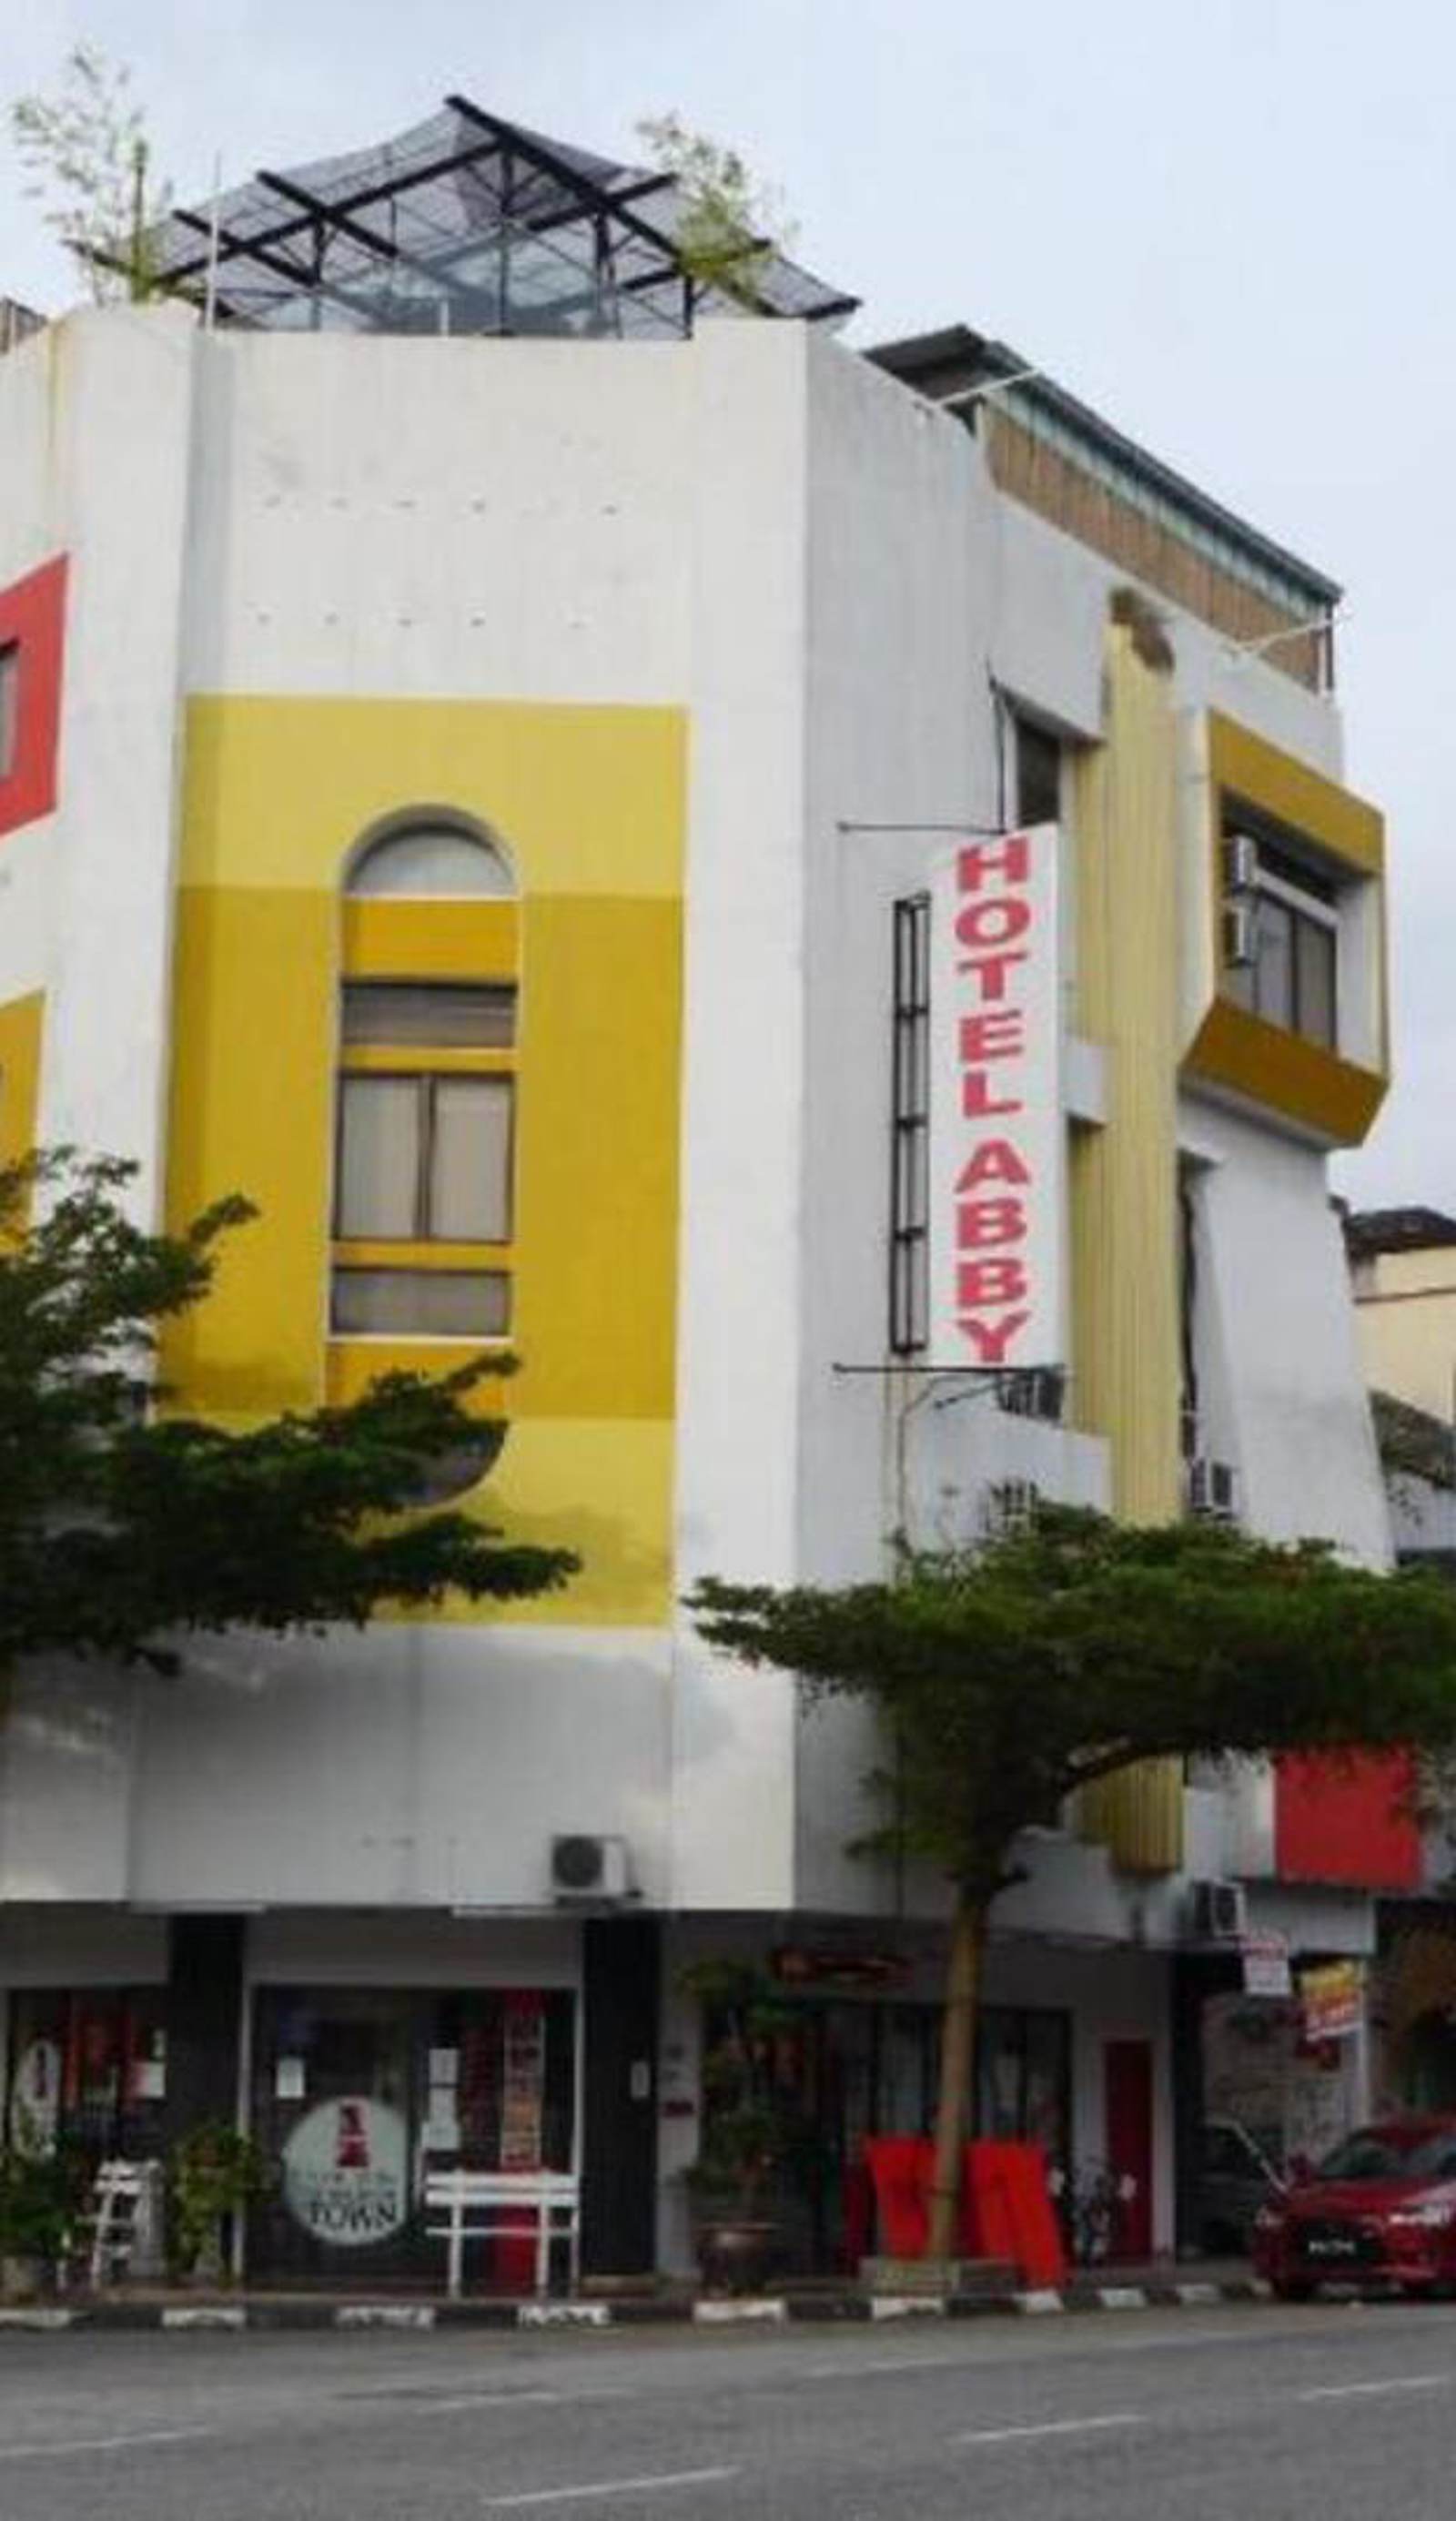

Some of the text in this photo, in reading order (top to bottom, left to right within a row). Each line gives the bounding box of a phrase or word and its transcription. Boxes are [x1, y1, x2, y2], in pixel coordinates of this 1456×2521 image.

[953, 837, 1031, 1363] HOTEL ABBY
[309, 2199, 398, 2232] TOWN
